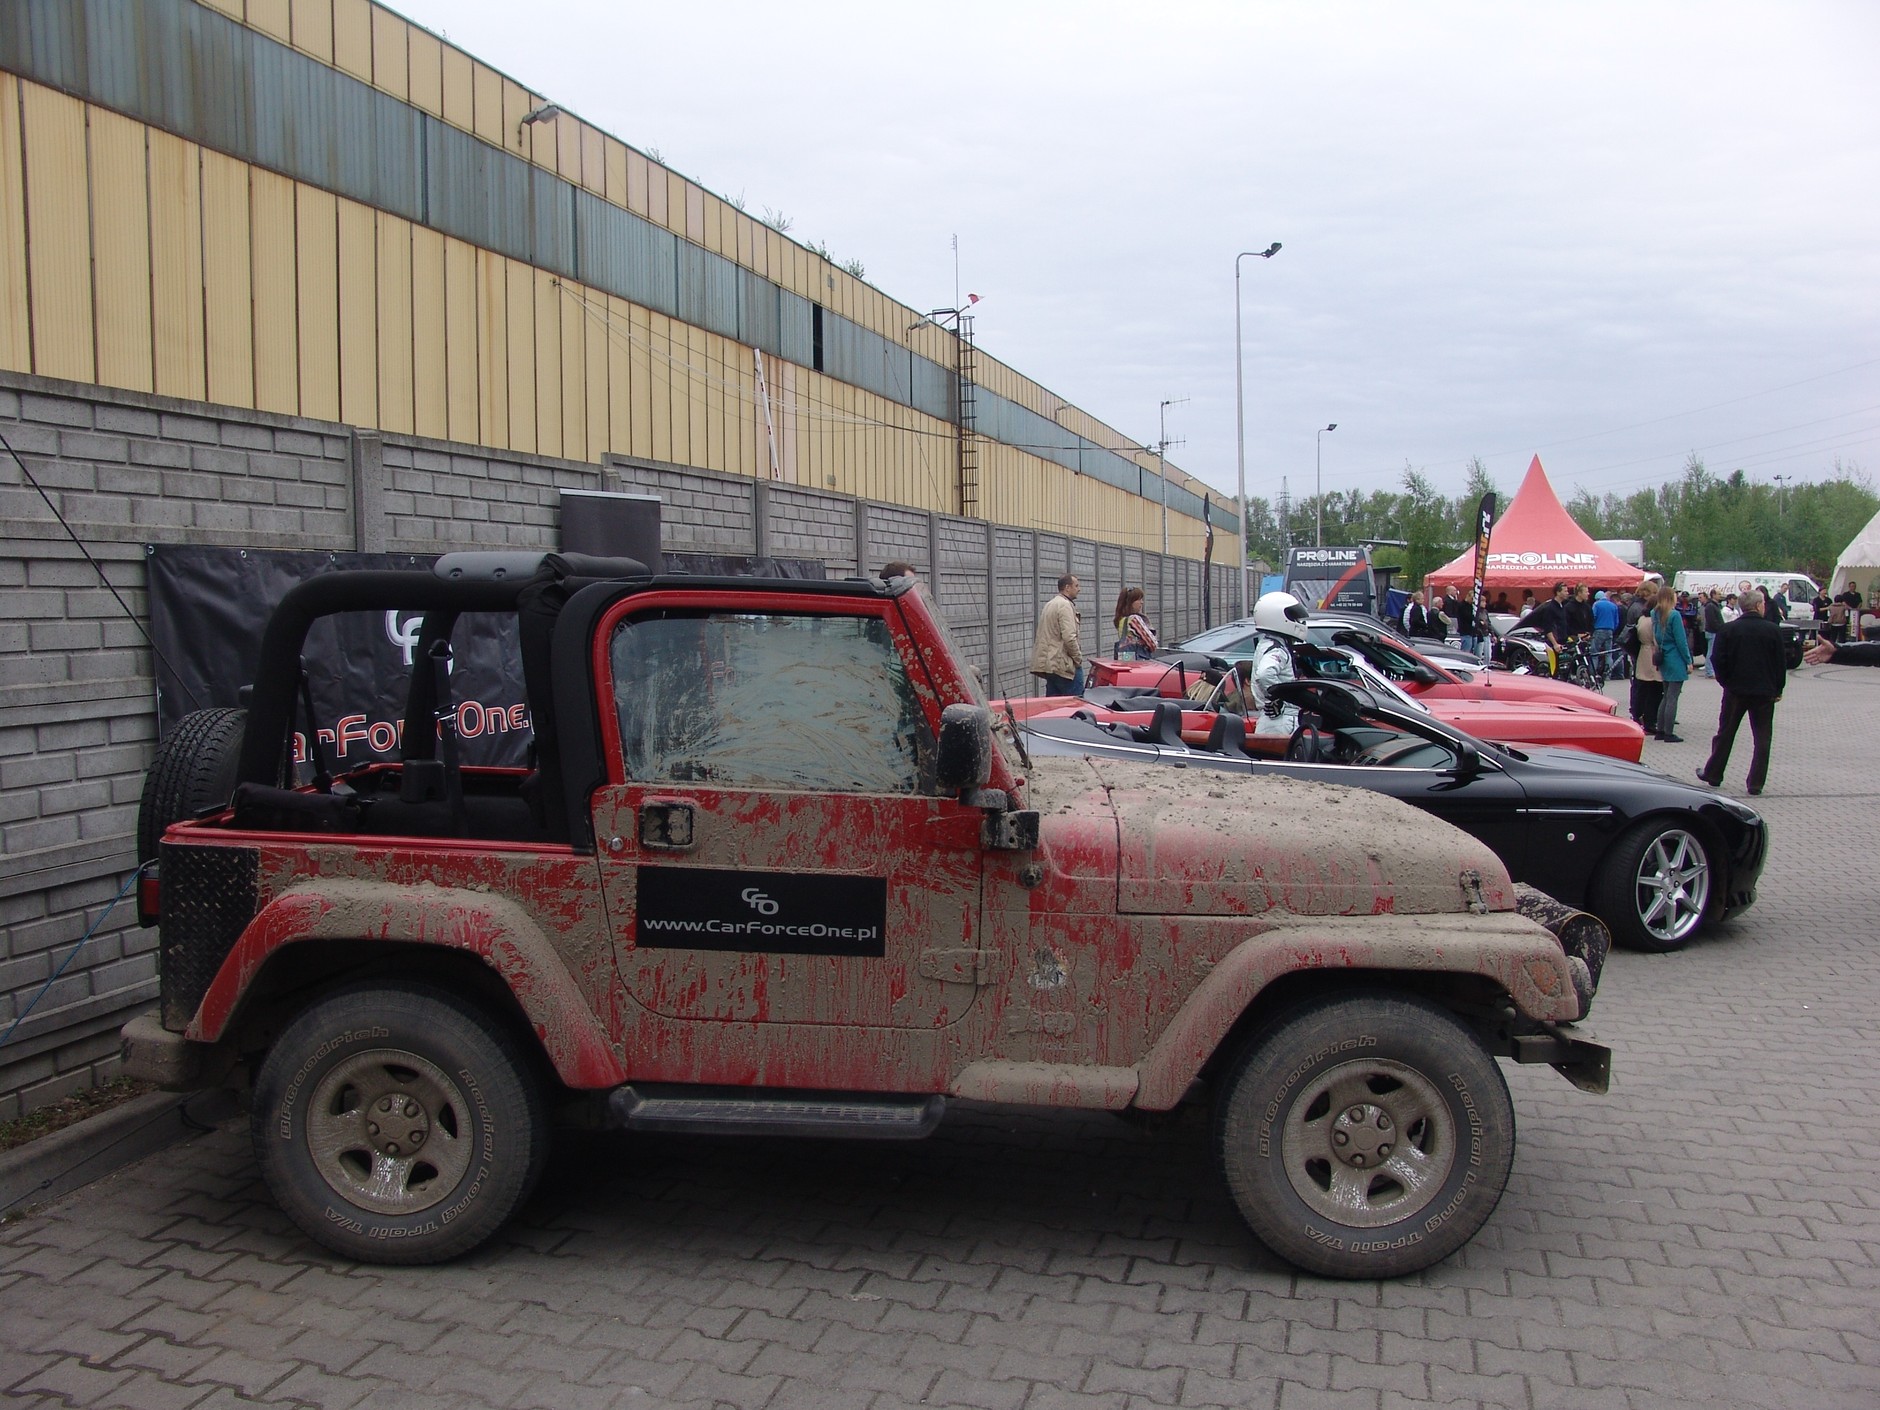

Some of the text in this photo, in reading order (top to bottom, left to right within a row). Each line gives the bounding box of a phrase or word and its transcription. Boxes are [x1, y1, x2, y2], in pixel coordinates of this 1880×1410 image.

[1297, 550, 1357, 561] PROLINE
[1486, 551, 1595, 566] PROLINE
[644, 919, 877, 941] www.CarForceOne.pl
[280, 1026, 389, 1139] BFGoodrich
[1259, 1035, 1377, 1158] BFGoodrich
[1448, 1073, 1482, 1167] Radial
[1426, 1174, 1478, 1234] Long
